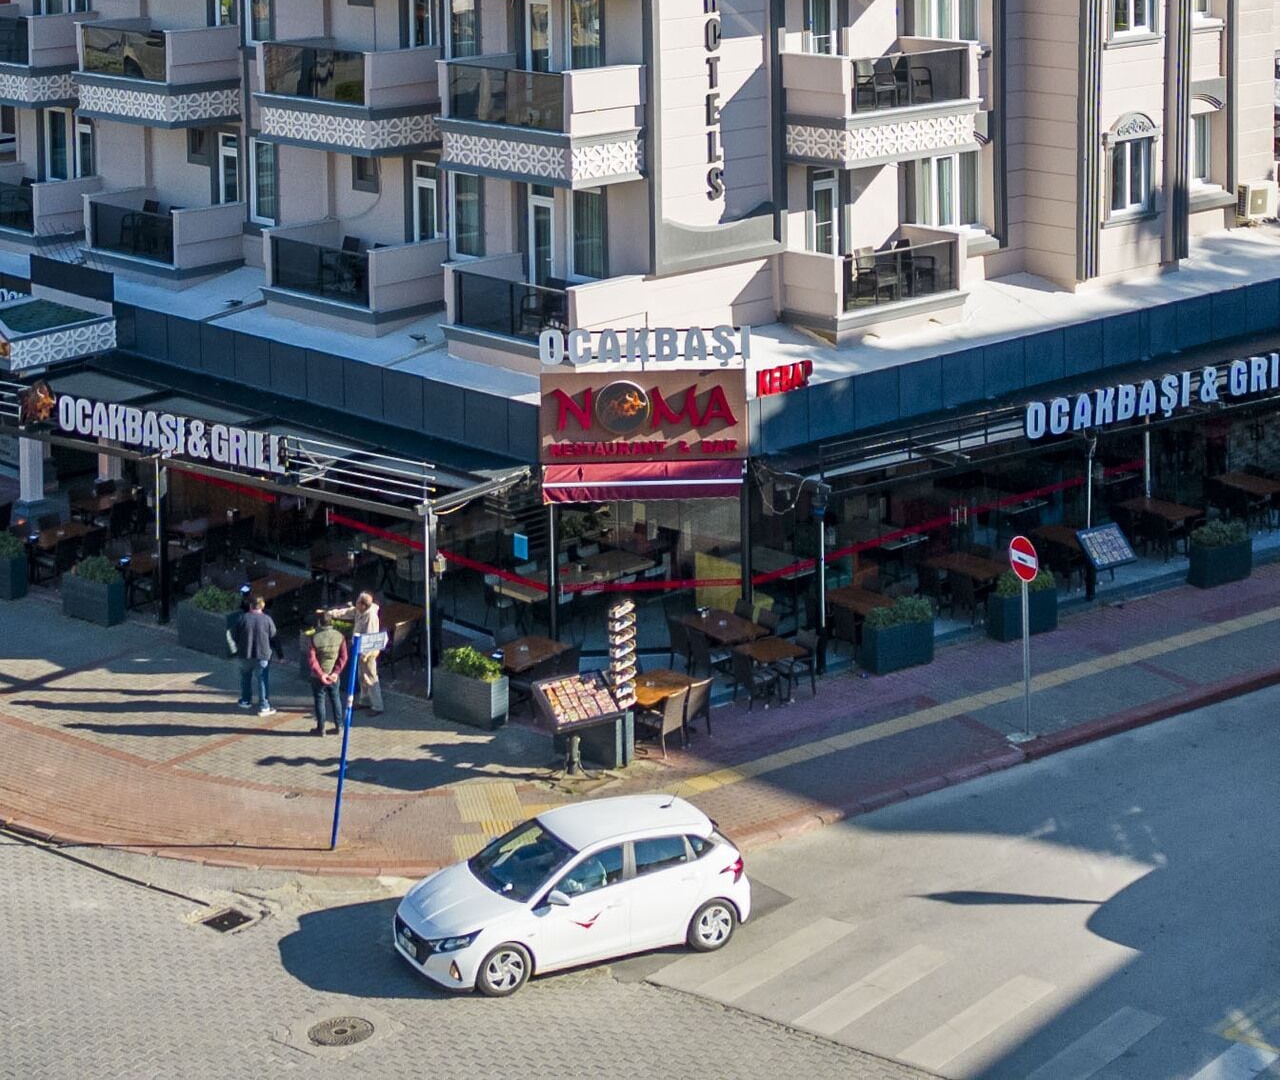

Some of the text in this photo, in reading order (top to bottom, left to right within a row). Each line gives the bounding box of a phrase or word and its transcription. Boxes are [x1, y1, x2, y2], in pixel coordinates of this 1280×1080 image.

[539, 325, 751, 367] OCAKBAŞI
[756, 359, 813, 397] KEBAP
[1025, 371, 1191, 439] OCAKBAŞI
[1199, 366, 1219, 404] &
[59, 394, 287, 475] OCAKBAŞI & GRILL
[550, 438, 738, 458] RESTAURANT & BAR
